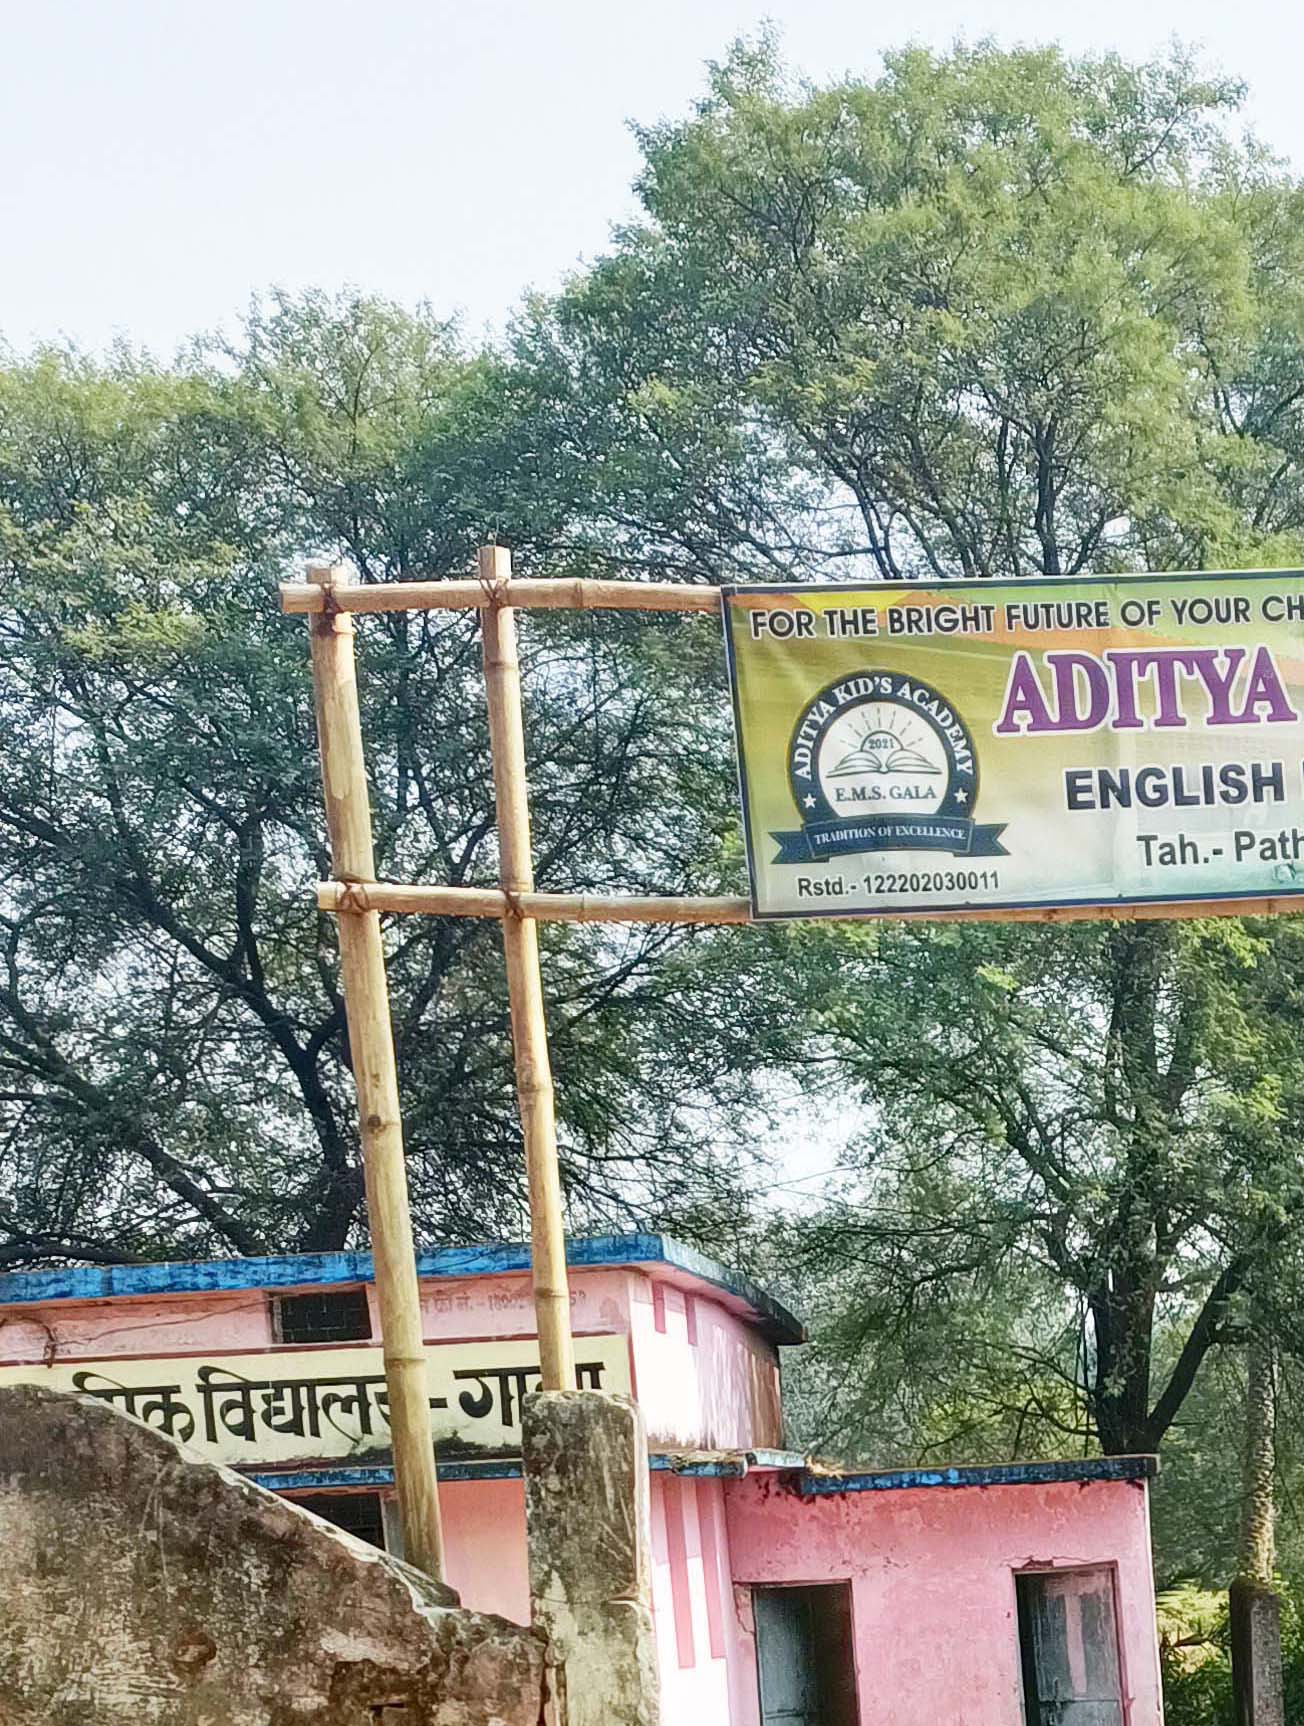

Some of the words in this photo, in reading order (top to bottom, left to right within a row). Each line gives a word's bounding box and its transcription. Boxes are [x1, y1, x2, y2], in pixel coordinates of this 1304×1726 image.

[752, 611, 814, 638] FOR
[824, 609, 879, 635] THE
[889, 605, 995, 633] BRIGHT
[1006, 602, 1109, 630] FUTURE
[1121, 598, 1161, 626] OF
[1171, 597, 1250, 625] YOUR
[997, 646, 1297, 733] ADITYA
[795, 700, 836, 780] ADITYA
[897, 681, 974, 776] ACADEMY
[835, 786, 886, 802] E.M.S.
[889, 785, 936, 799] GALA
[1067, 762, 1284, 810] ENGLISH
[814, 827, 875, 844] TRADITION
[877, 825, 894, 837] OF
[896, 825, 966, 839] EXCELLENCE
[1136, 833, 1223, 866] Tah.-
[863, 871, 999, 893] 122202030011
